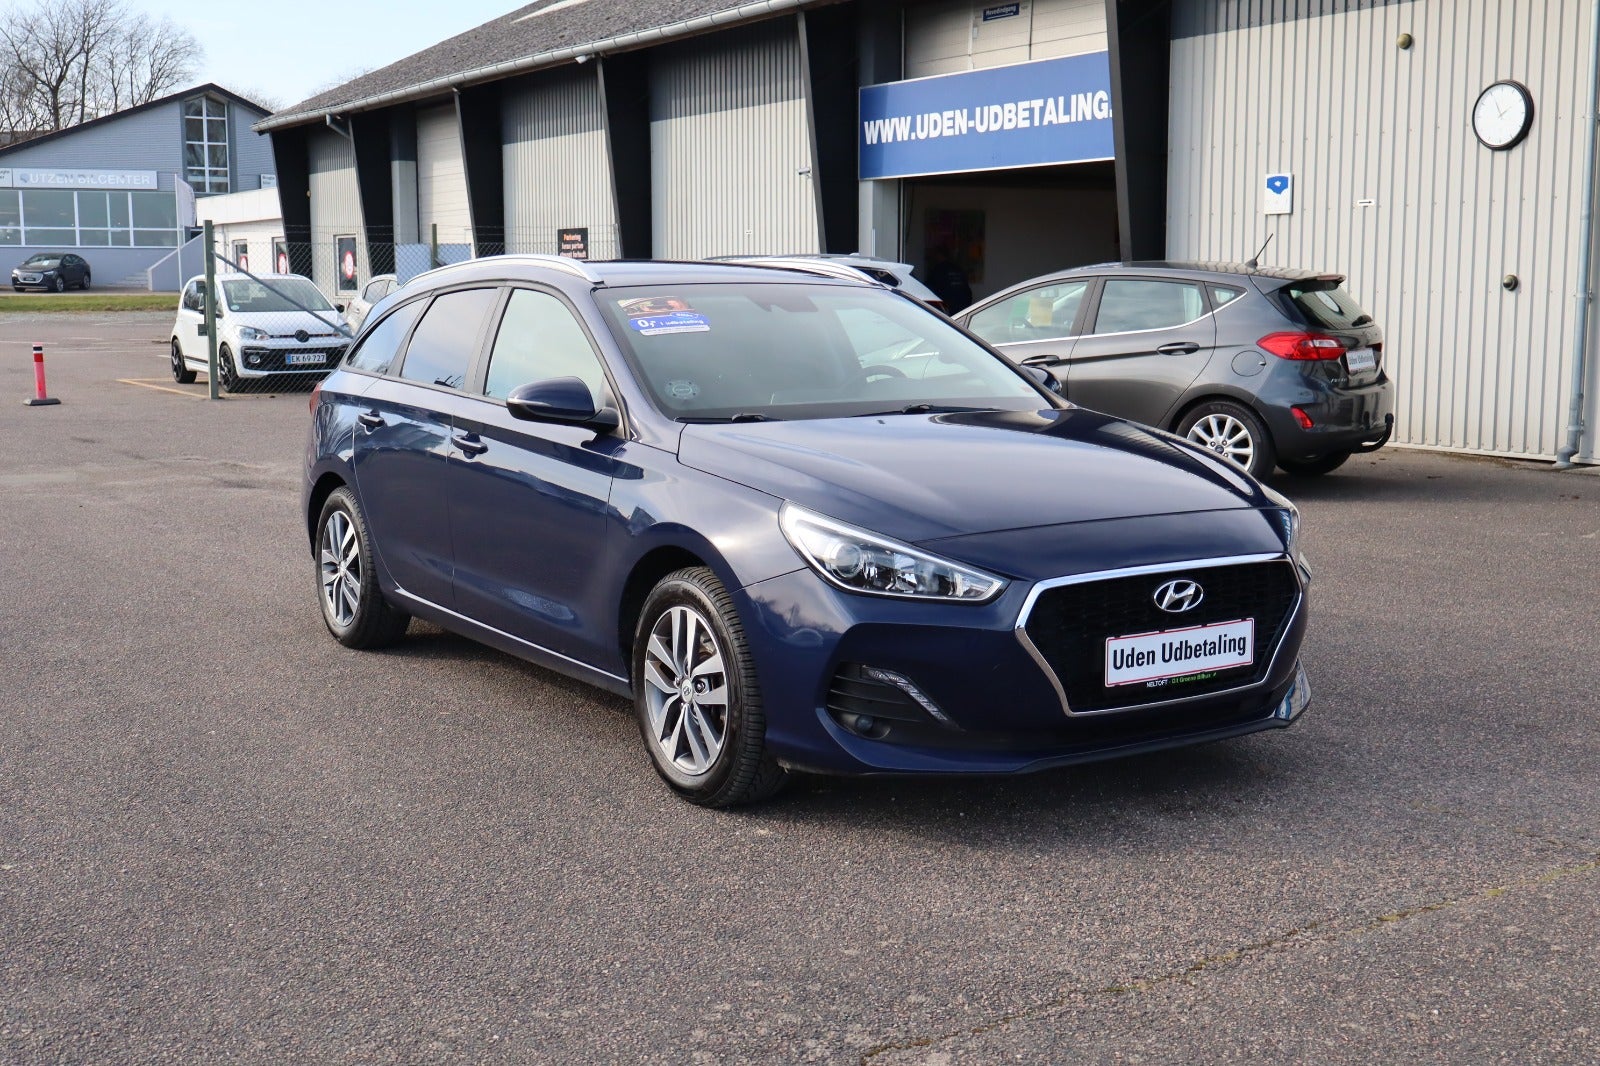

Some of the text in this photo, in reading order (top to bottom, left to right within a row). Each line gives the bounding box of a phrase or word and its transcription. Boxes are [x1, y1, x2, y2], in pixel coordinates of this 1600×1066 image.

[77, 174, 151, 185] BILCENTER
[291, 355, 301, 363] EK
[1112, 633, 1247, 670] Uden Udbetaling
